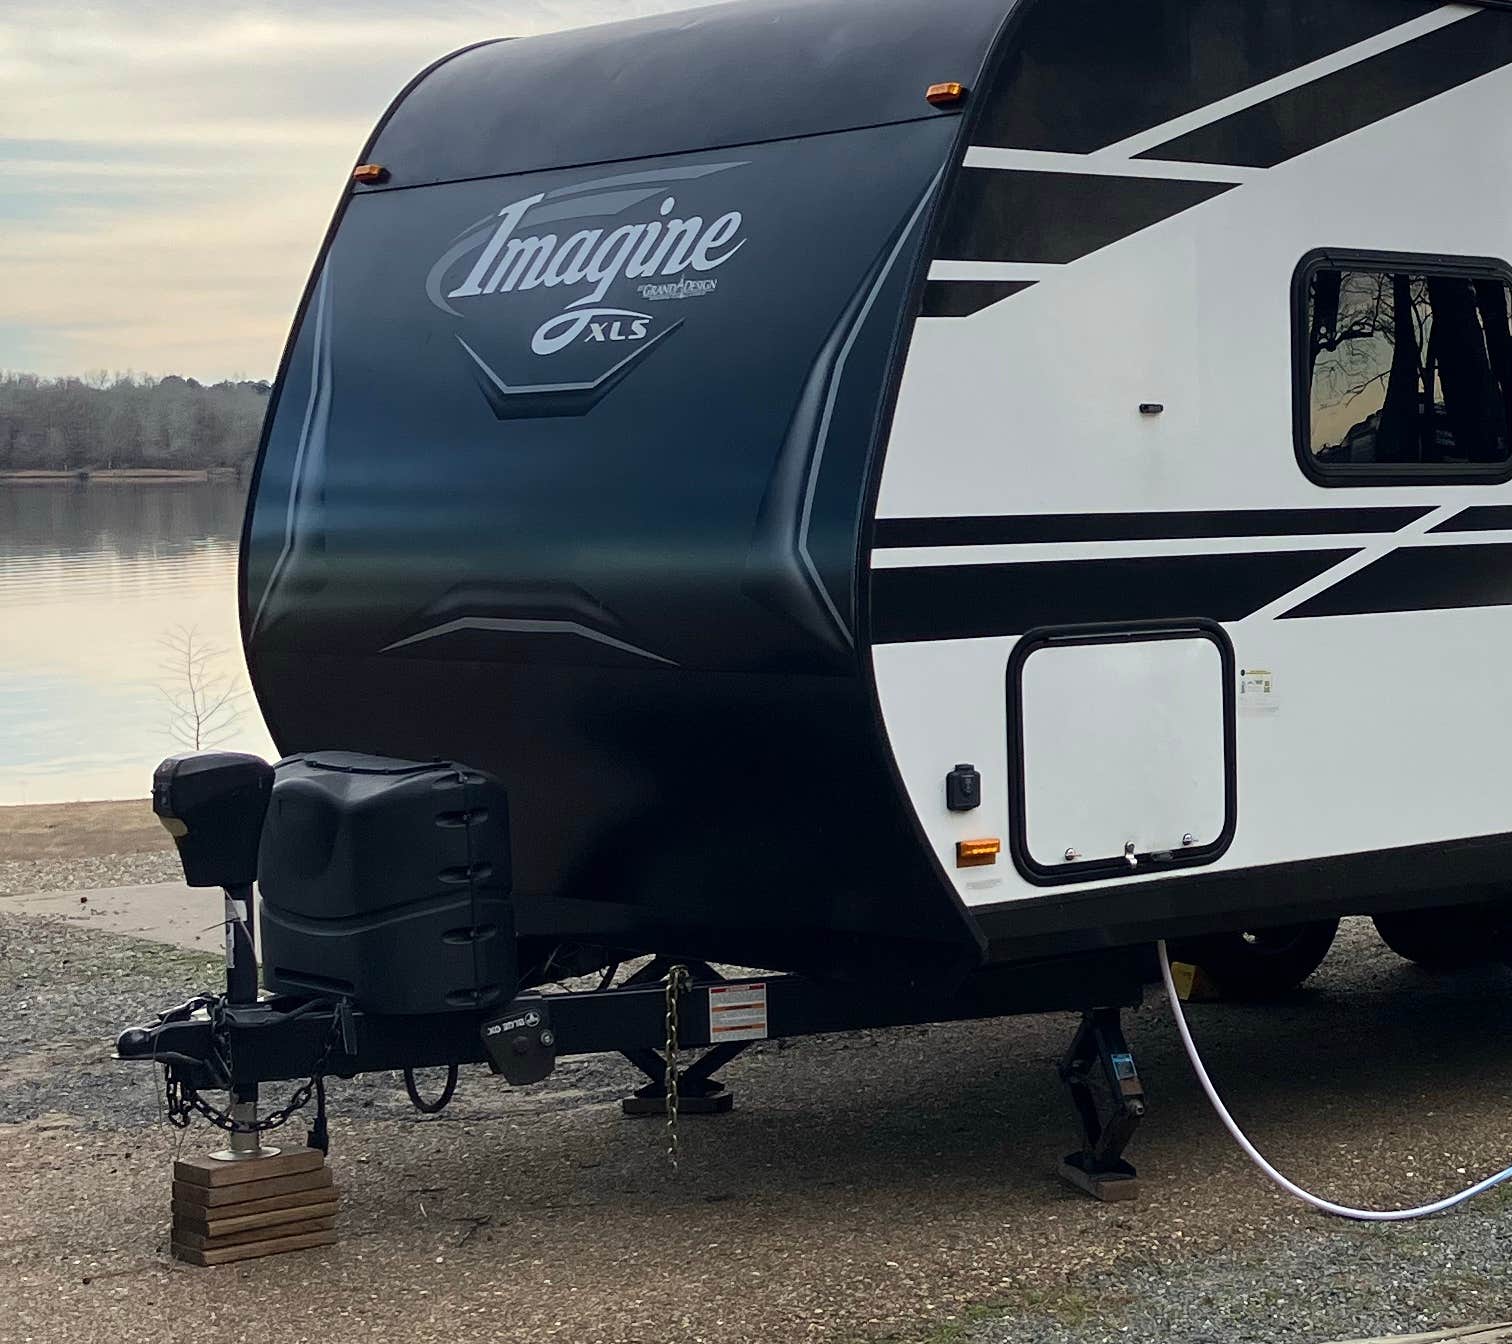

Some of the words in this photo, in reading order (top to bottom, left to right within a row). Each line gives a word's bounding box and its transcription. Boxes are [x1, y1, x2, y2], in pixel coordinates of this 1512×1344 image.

[448, 193, 747, 355] Imagine
[642, 283, 678, 298] GRAND
[684, 279, 718, 294] DESIGN
[584, 319, 650, 343] XLS
